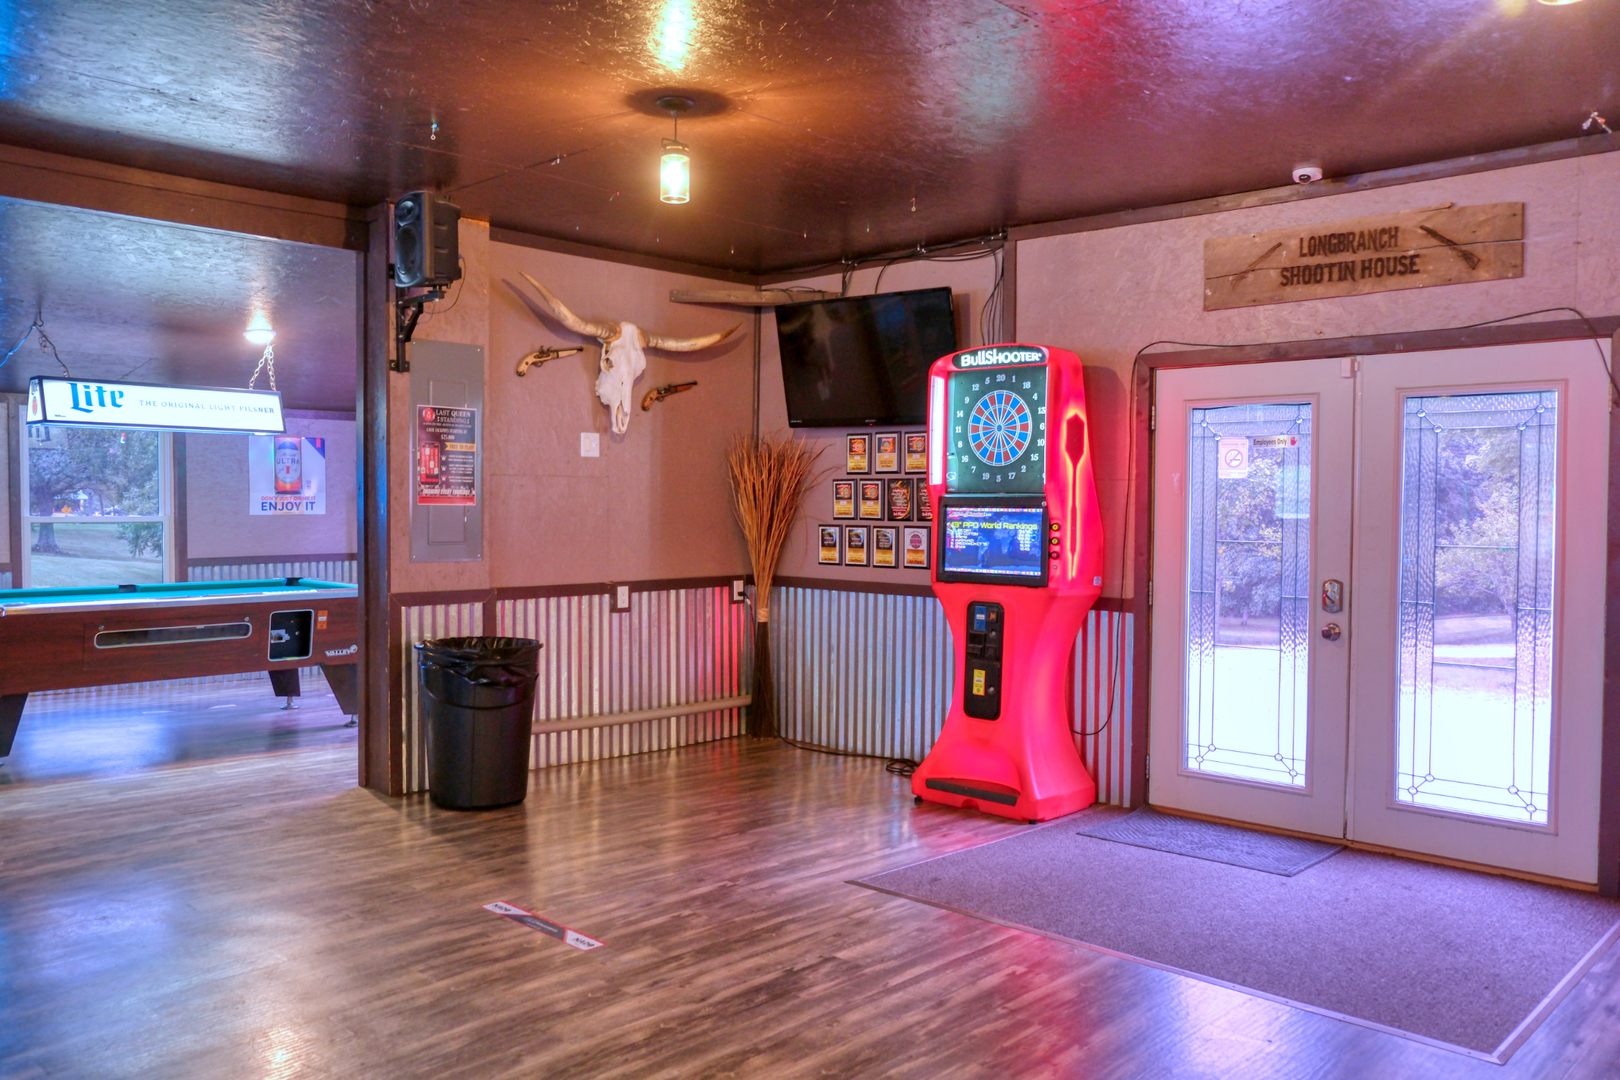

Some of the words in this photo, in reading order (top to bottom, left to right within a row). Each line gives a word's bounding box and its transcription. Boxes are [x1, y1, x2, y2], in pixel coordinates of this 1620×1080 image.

[1299, 226, 1400, 258] LONGBRANCH
[1280, 260, 1356, 287] SHOOTIN
[1361, 253, 1421, 279] HOUSE
[996, 374, 1006, 382] 20
[1012, 375, 1016, 383] 1
[66, 382, 124, 413] Lite
[161, 401, 206, 410] ORIGINAL
[240, 406, 275, 414] PILSNER
[1253, 438, 1276, 447] Employees
[1277, 438, 1287, 446] Only
[261, 501, 301, 511] ENJOY
[306, 501, 316, 511] IT
[324, 648, 350, 657] VALLEY
